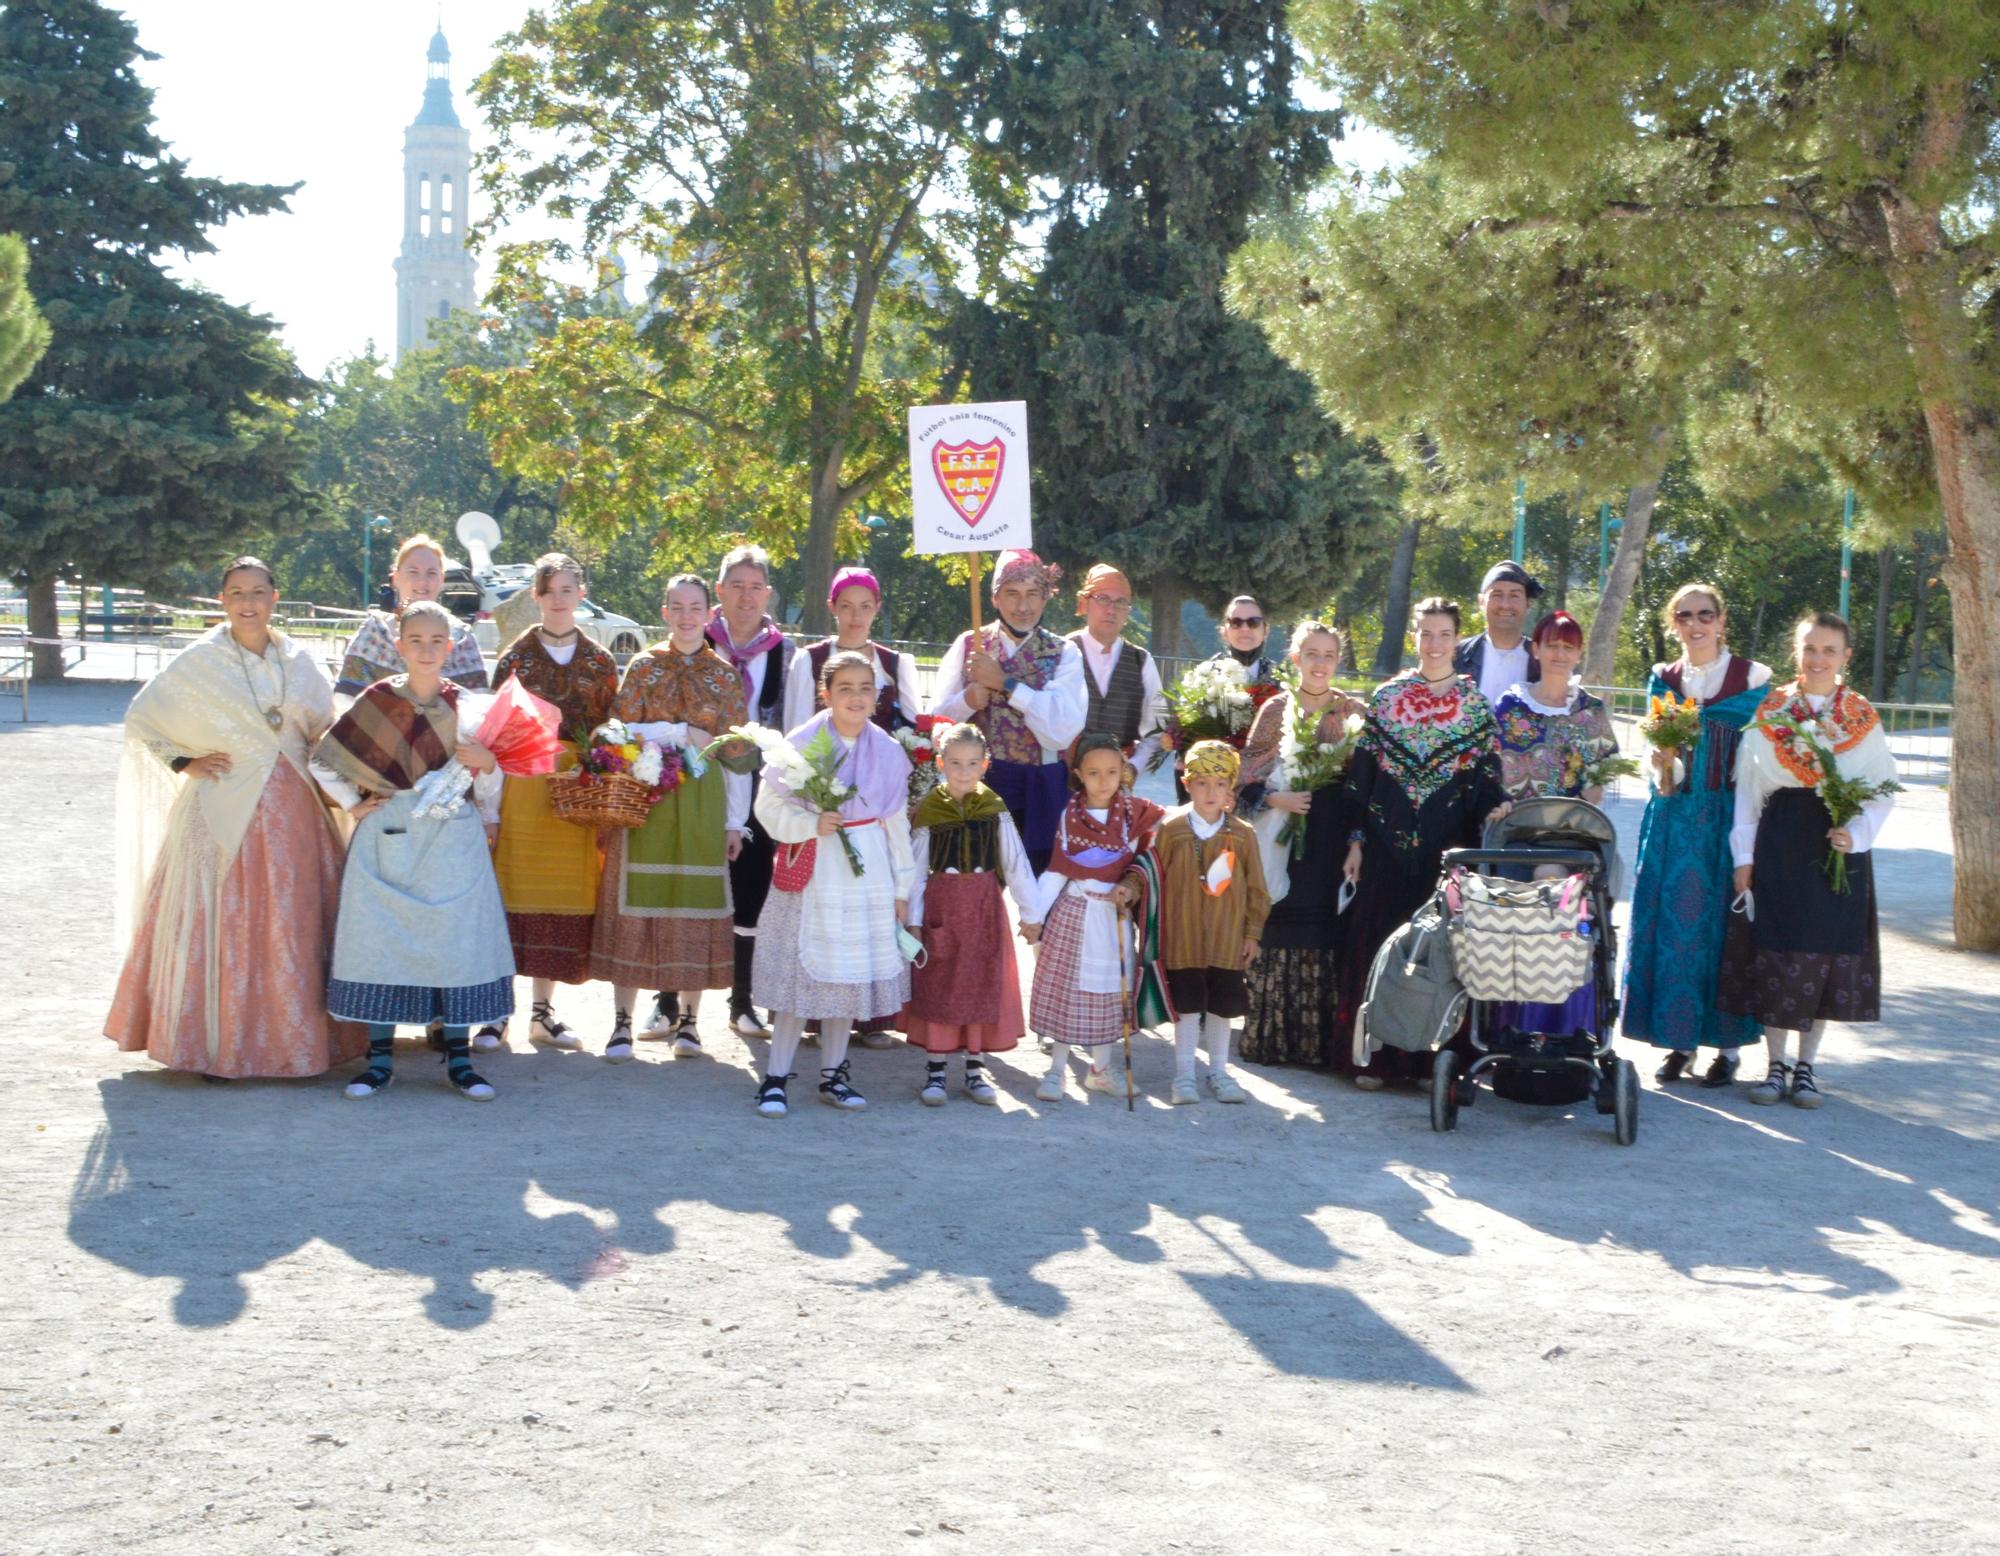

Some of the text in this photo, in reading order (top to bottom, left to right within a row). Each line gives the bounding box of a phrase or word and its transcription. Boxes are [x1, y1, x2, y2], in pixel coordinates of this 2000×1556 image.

[949, 412, 970, 422] sala
[973, 412, 1016, 437] femenino
[955, 476, 985, 493] C.A.
[968, 523, 1009, 541] Augusta
